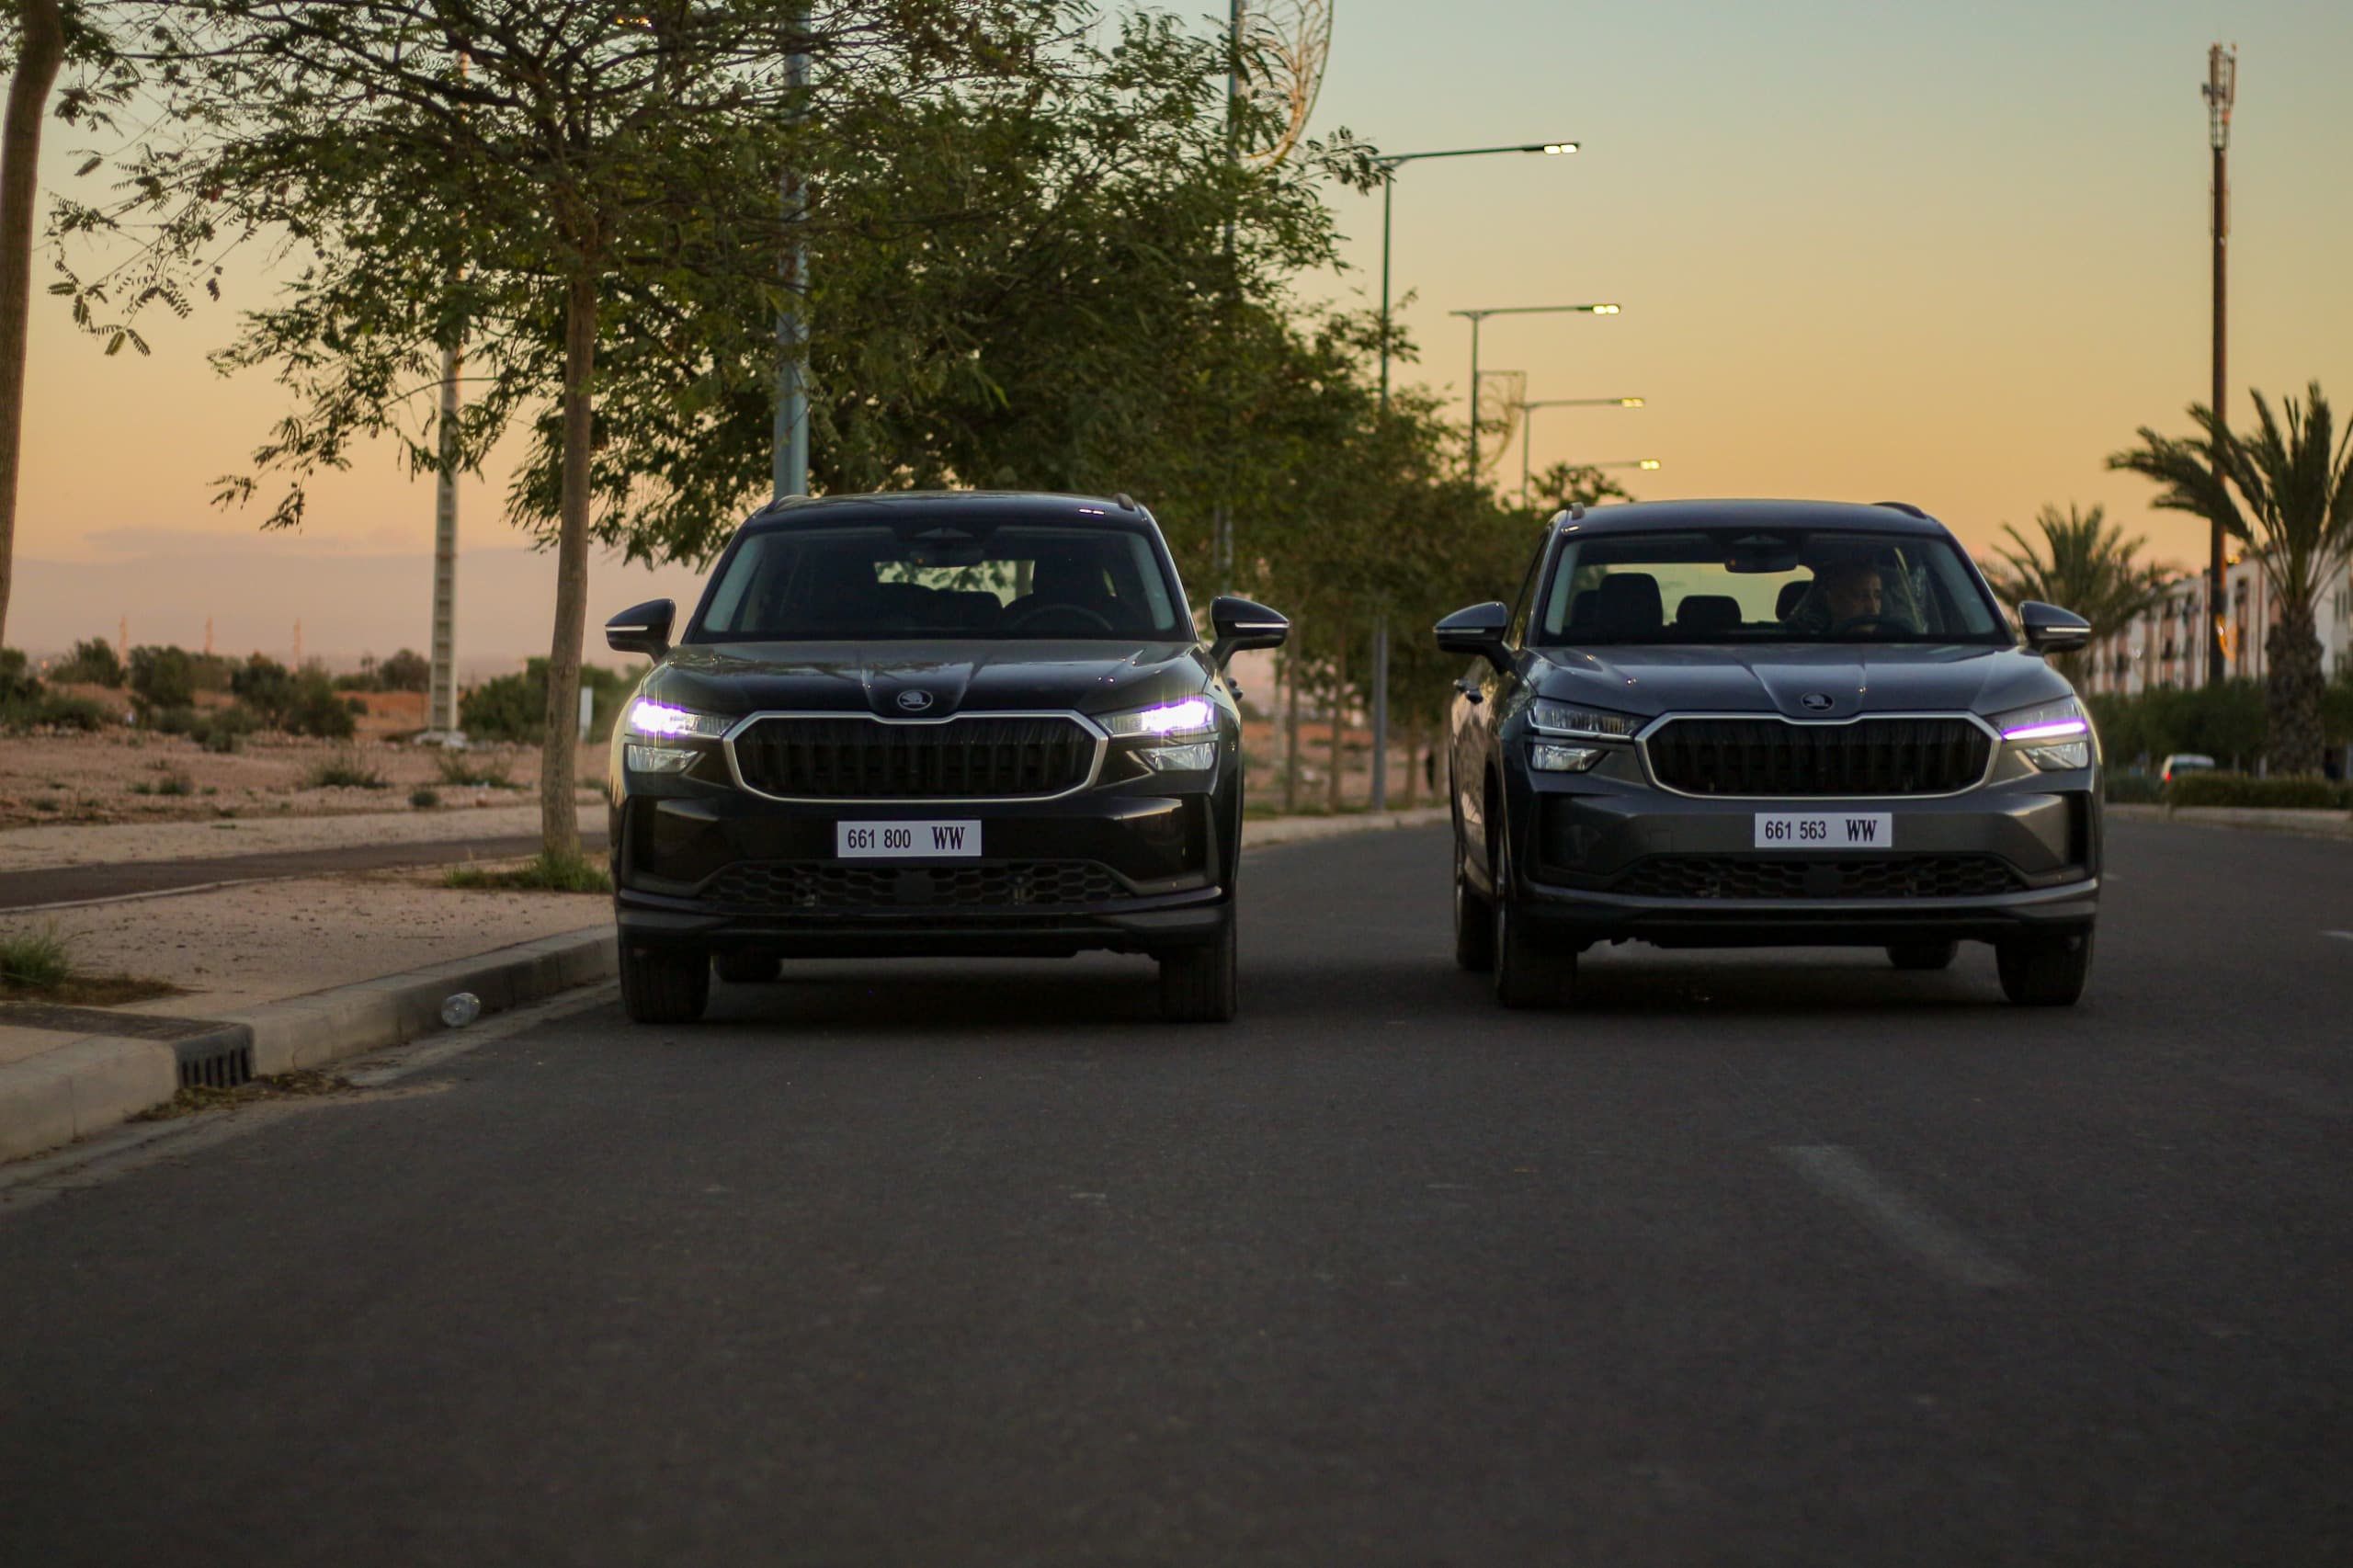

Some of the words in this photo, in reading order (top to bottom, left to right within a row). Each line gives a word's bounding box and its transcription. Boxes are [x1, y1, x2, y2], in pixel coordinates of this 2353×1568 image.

[847, 829, 875, 848] 661
[883, 829, 912, 848] 800
[931, 826, 966, 850] WW
[1765, 821, 1791, 840] 661
[1799, 821, 1827, 840] 563
[1845, 819, 1878, 842] WW
